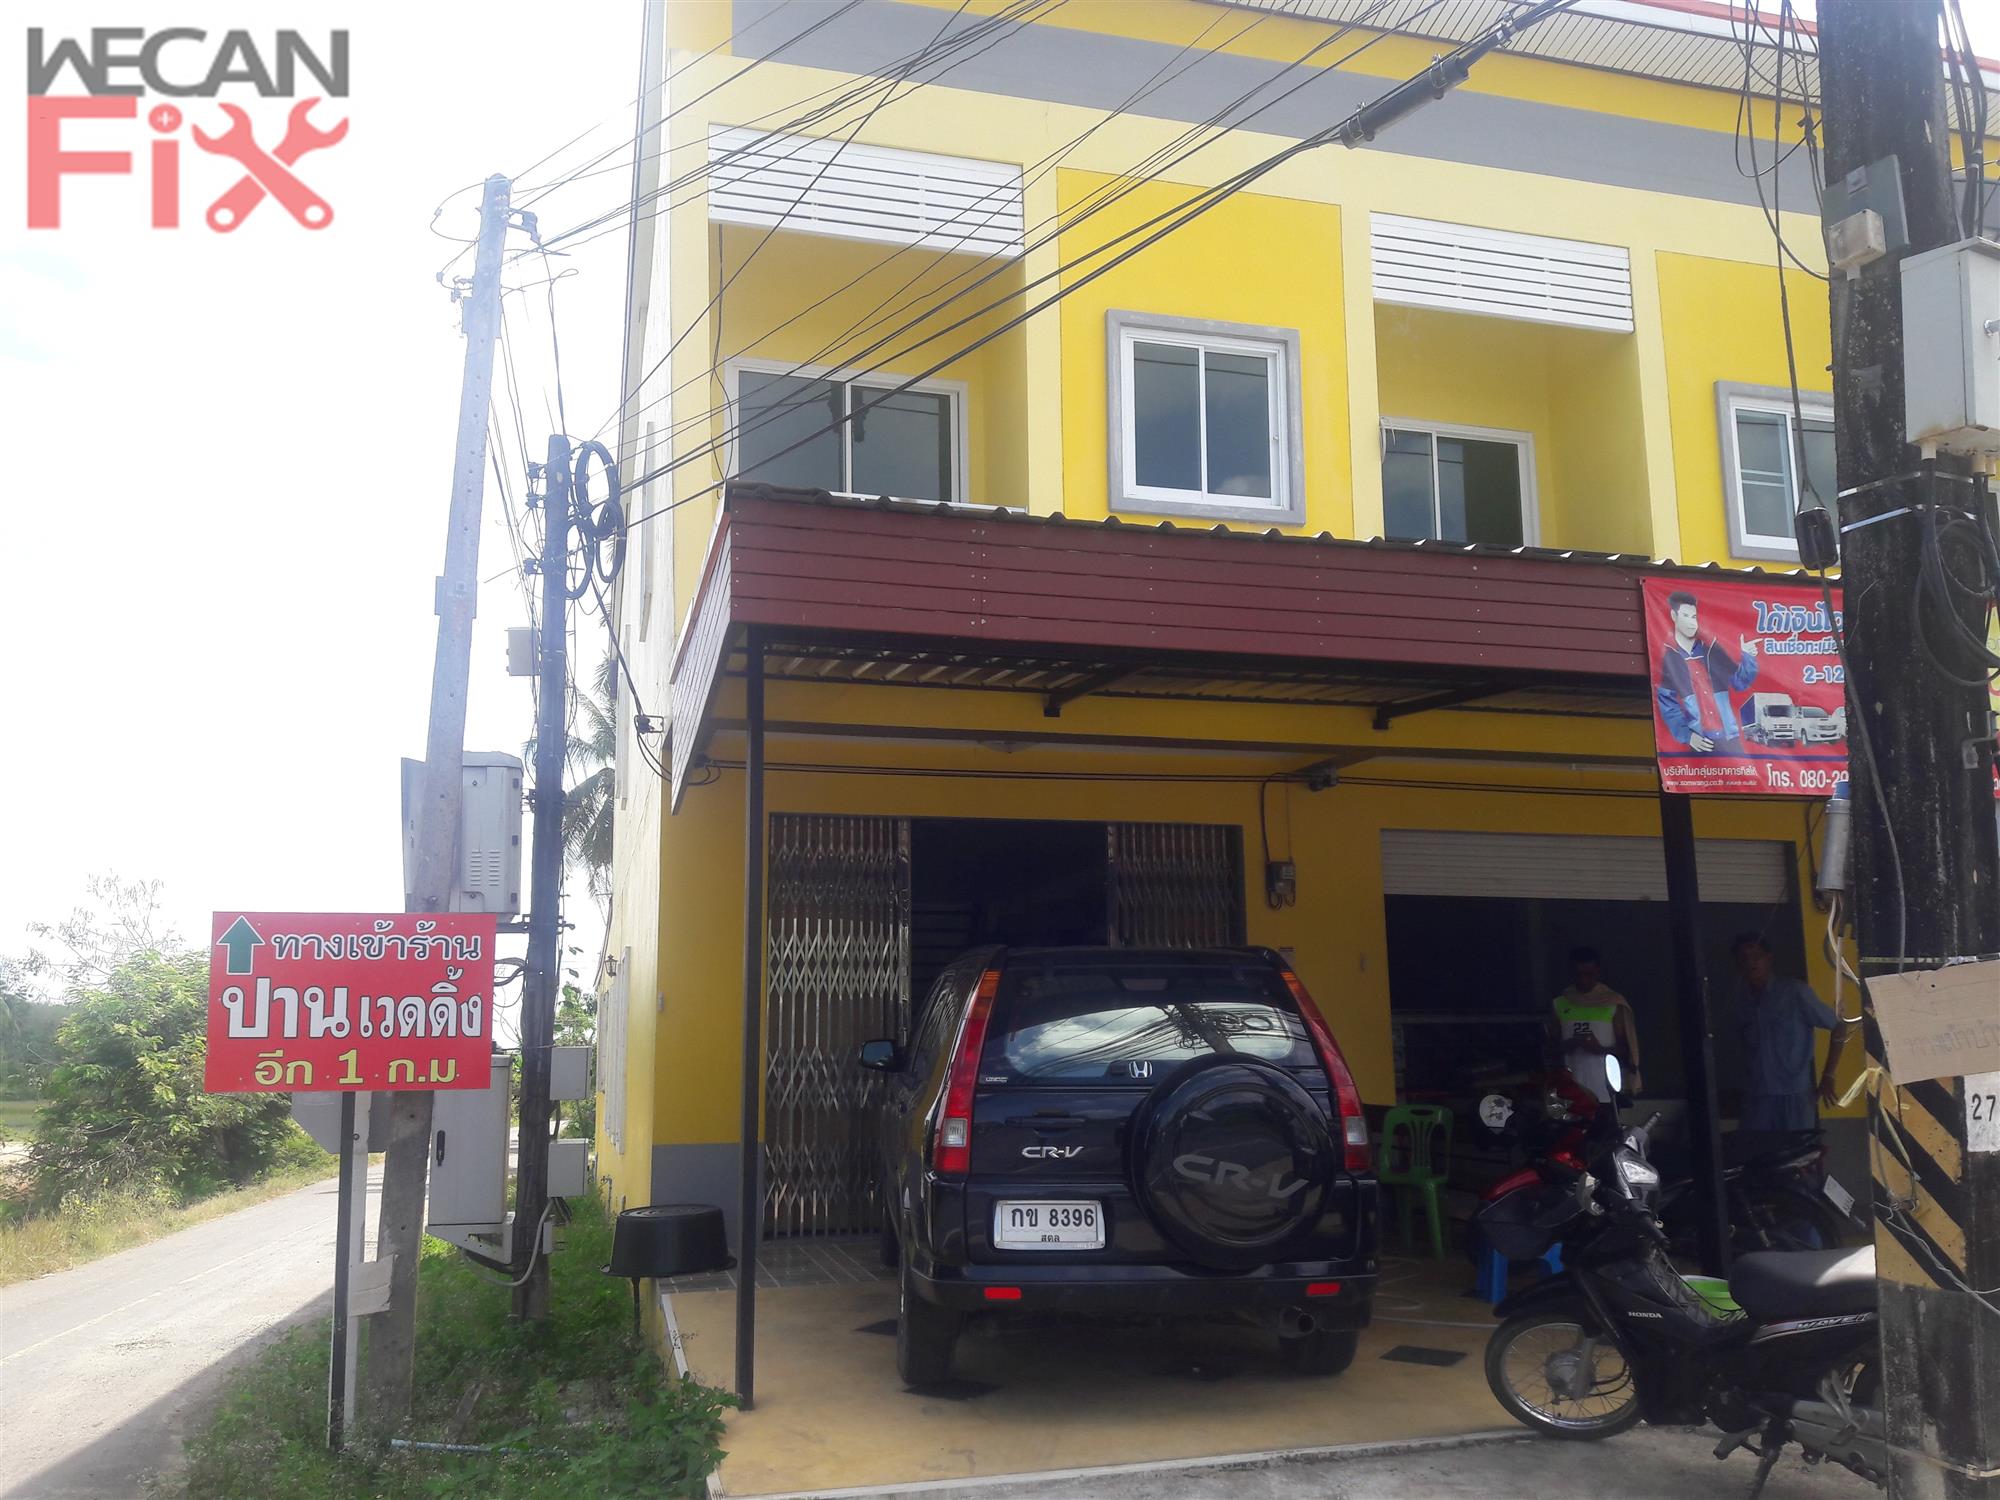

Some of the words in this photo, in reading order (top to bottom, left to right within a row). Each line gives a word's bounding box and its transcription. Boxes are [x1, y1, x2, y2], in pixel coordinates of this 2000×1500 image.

[1766, 763, 1794, 787] โทร.
[272, 919, 482, 961] ทางเข้าร้าน
[221, 977, 350, 1039] ปาน
[359, 965, 483, 1038] เวดดิ้ง
[254, 1049, 314, 1085] อีก
[338, 1049, 364, 1085] 1
[1971, 1092, 1996, 1121] 27
[1021, 1146, 1085, 1159] CR-V
[1172, 1154, 1310, 1199] CR-V
[1011, 1208, 1038, 1228] กข
[1049, 1208, 1094, 1228] 8396
[1627, 1311, 1664, 1319] HONDA
